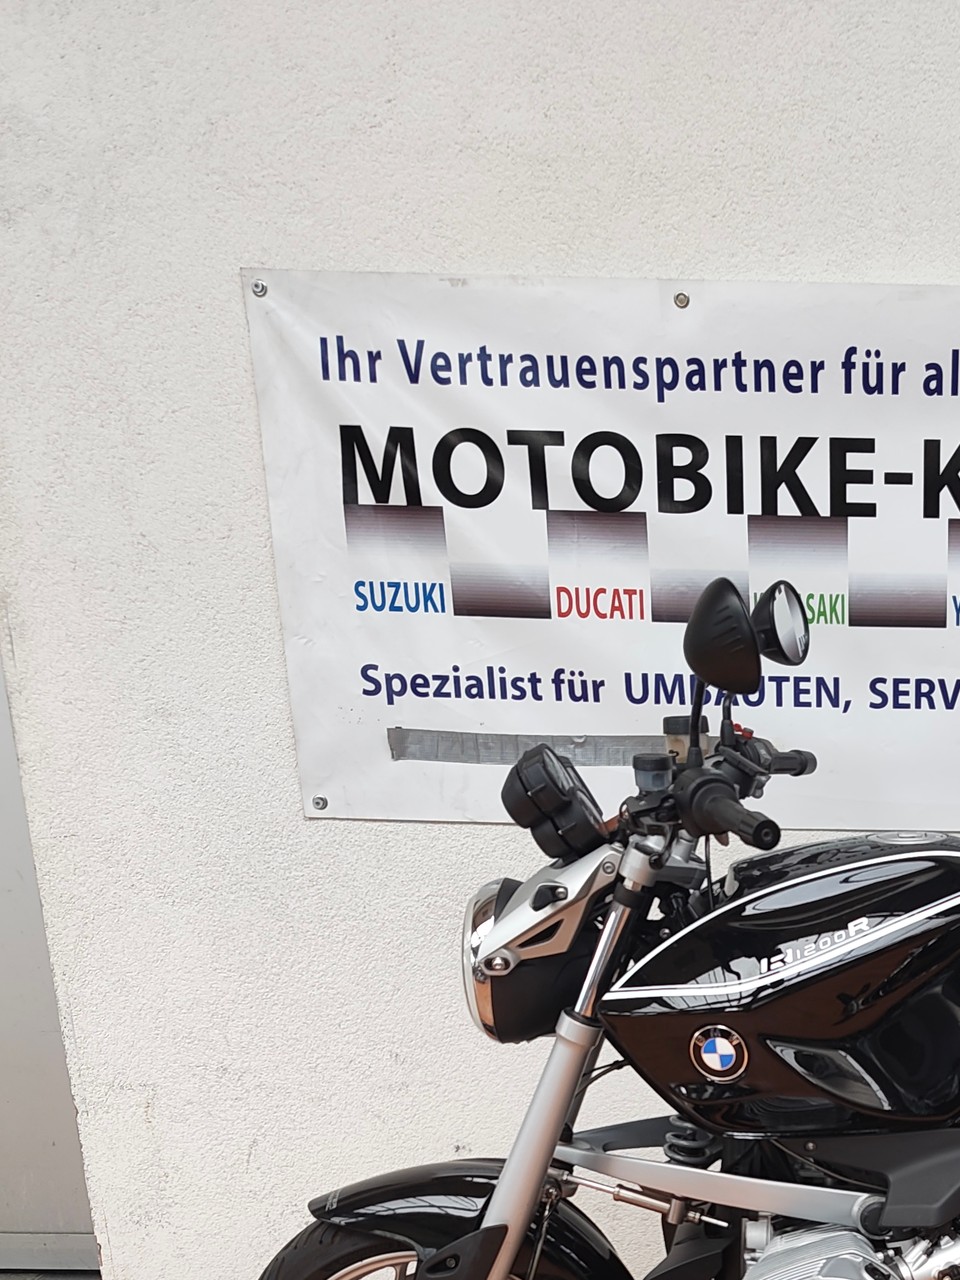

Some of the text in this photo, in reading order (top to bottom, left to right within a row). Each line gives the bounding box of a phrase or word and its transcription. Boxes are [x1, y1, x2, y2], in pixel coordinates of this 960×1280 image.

[319, 335, 382, 383] Ihr
[396, 338, 826, 403] Vertrauenspartner
[841, 346, 907, 396] für
[353, 579, 447, 614] SUZUKI
[555, 585, 646, 621] DUCATI
[360, 663, 544, 705] Spezialist
[551, 667, 606, 704] für
